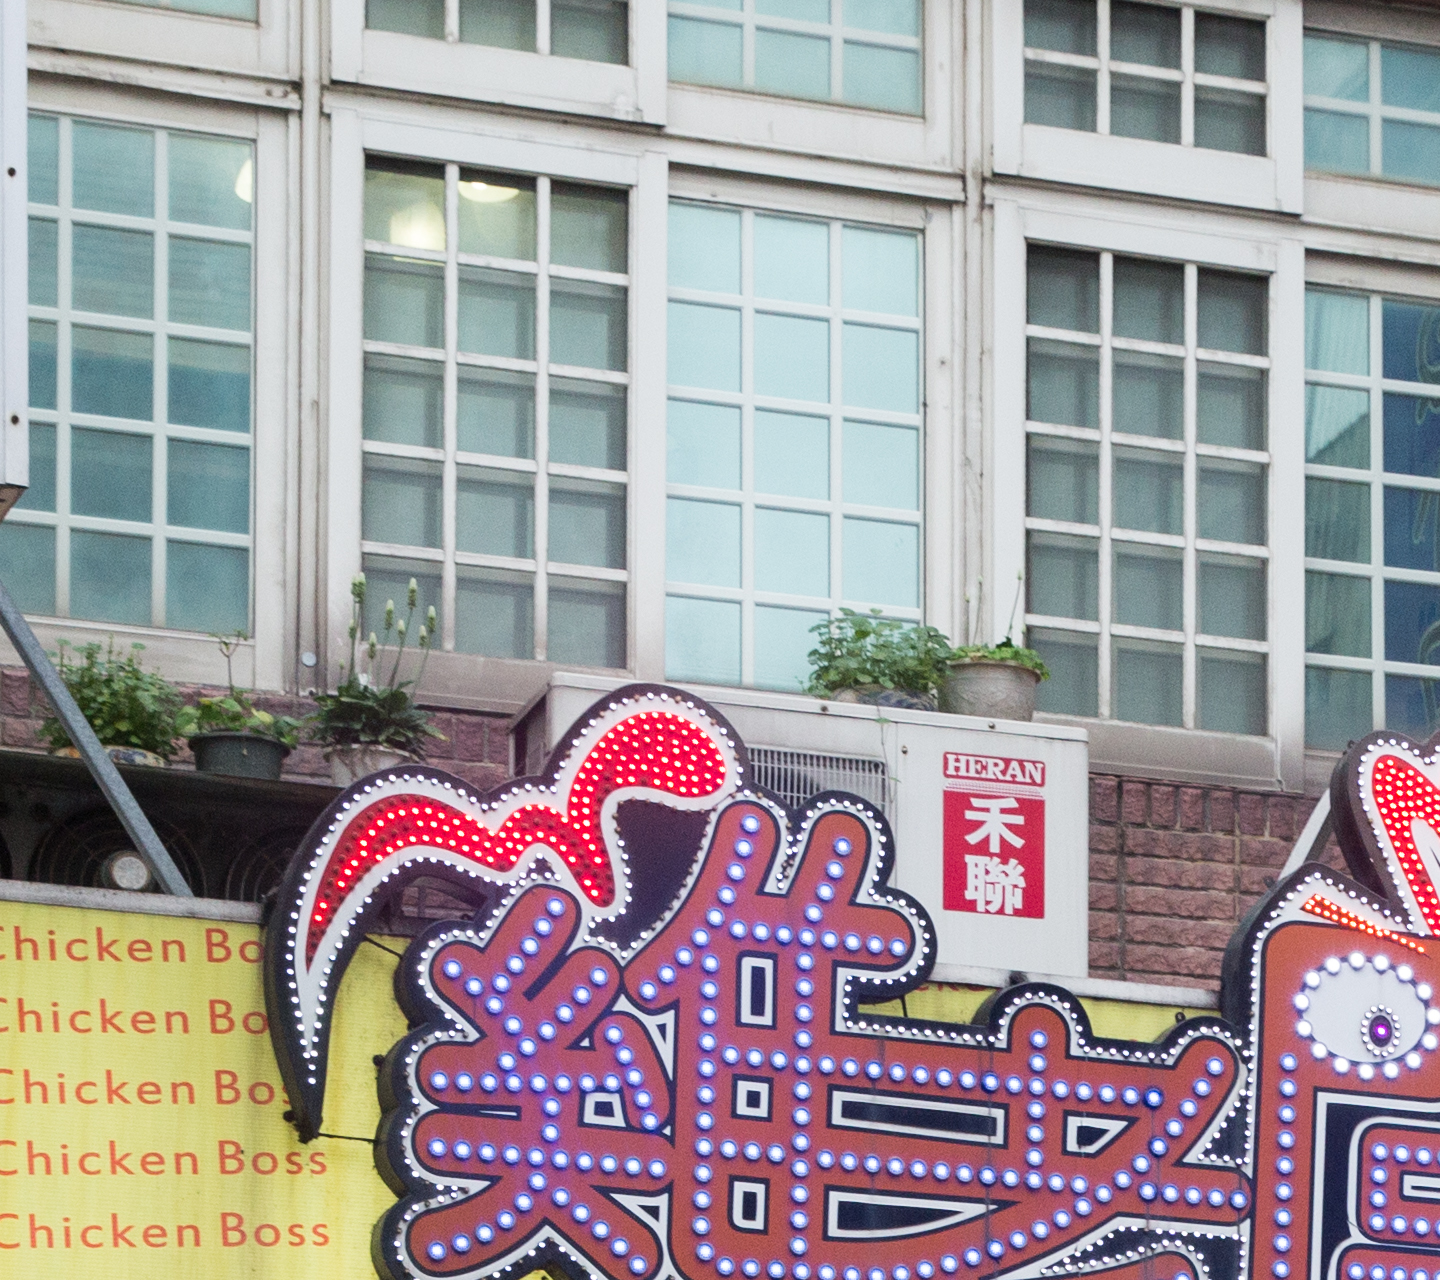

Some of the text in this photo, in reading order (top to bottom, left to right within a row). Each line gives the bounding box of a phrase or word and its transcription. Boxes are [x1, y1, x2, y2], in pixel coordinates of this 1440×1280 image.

[943, 753, 1045, 786] HERAN
[962, 795, 1030, 917] 禾聯
[205, 928, 260, 963] Bo
[209, 999, 264, 1034] Bo
[218, 1140, 327, 1175] Boss
[221, 1212, 329, 1247] Boss
